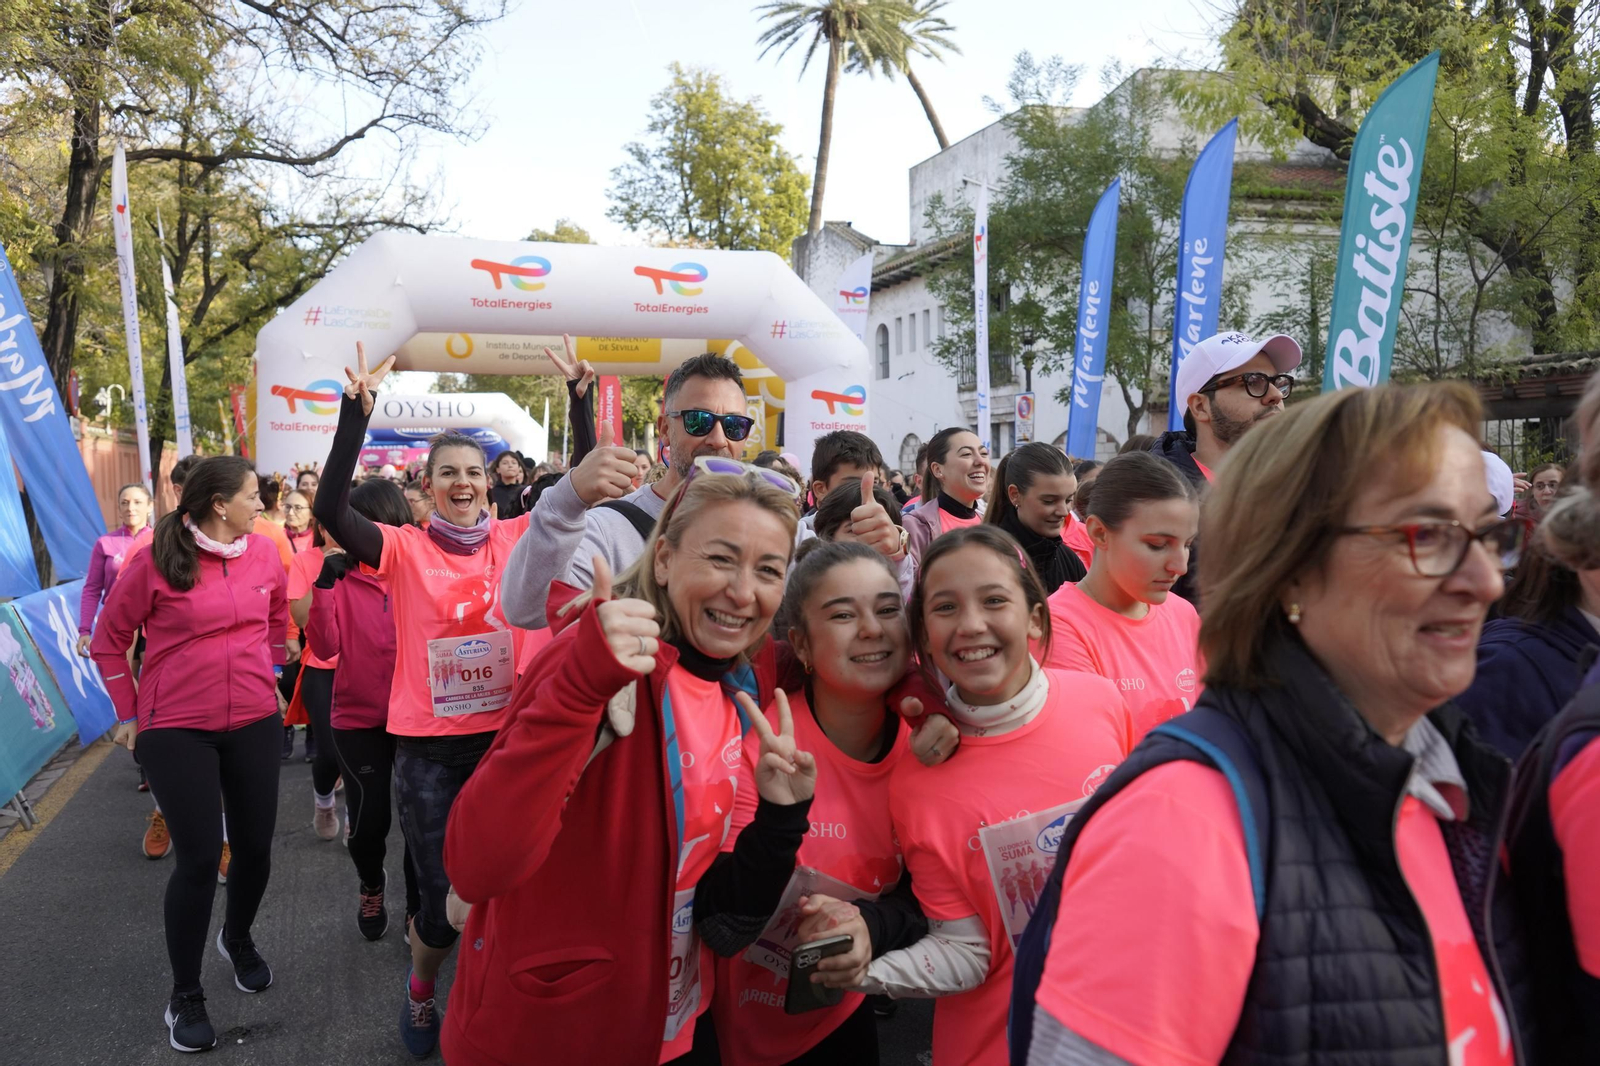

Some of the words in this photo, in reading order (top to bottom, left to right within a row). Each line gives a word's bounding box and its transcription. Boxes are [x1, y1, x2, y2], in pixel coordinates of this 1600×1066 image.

[1333, 137, 1414, 392] Batiste
[471, 297, 552, 311] TotalEnergies
[634, 302, 709, 315] TotalEnergies
[486, 341, 520, 350] Instituto
[1074, 280, 1102, 408] Marlene
[499, 352, 509, 360] de
[384, 401, 475, 418] OYSHO
[270, 421, 338, 434] TotalEnergie
[810, 421, 866, 432] TotalEnergies
[425, 568, 461, 580] OYSHO
[461, 666, 493, 682] 016
[1116, 678, 1145, 691] SHO
[443, 703, 472, 713] OYSHO
[809, 821, 847, 839] SHO
[1001, 845, 1034, 861] SUMA
[764, 954, 789, 972] OYS
